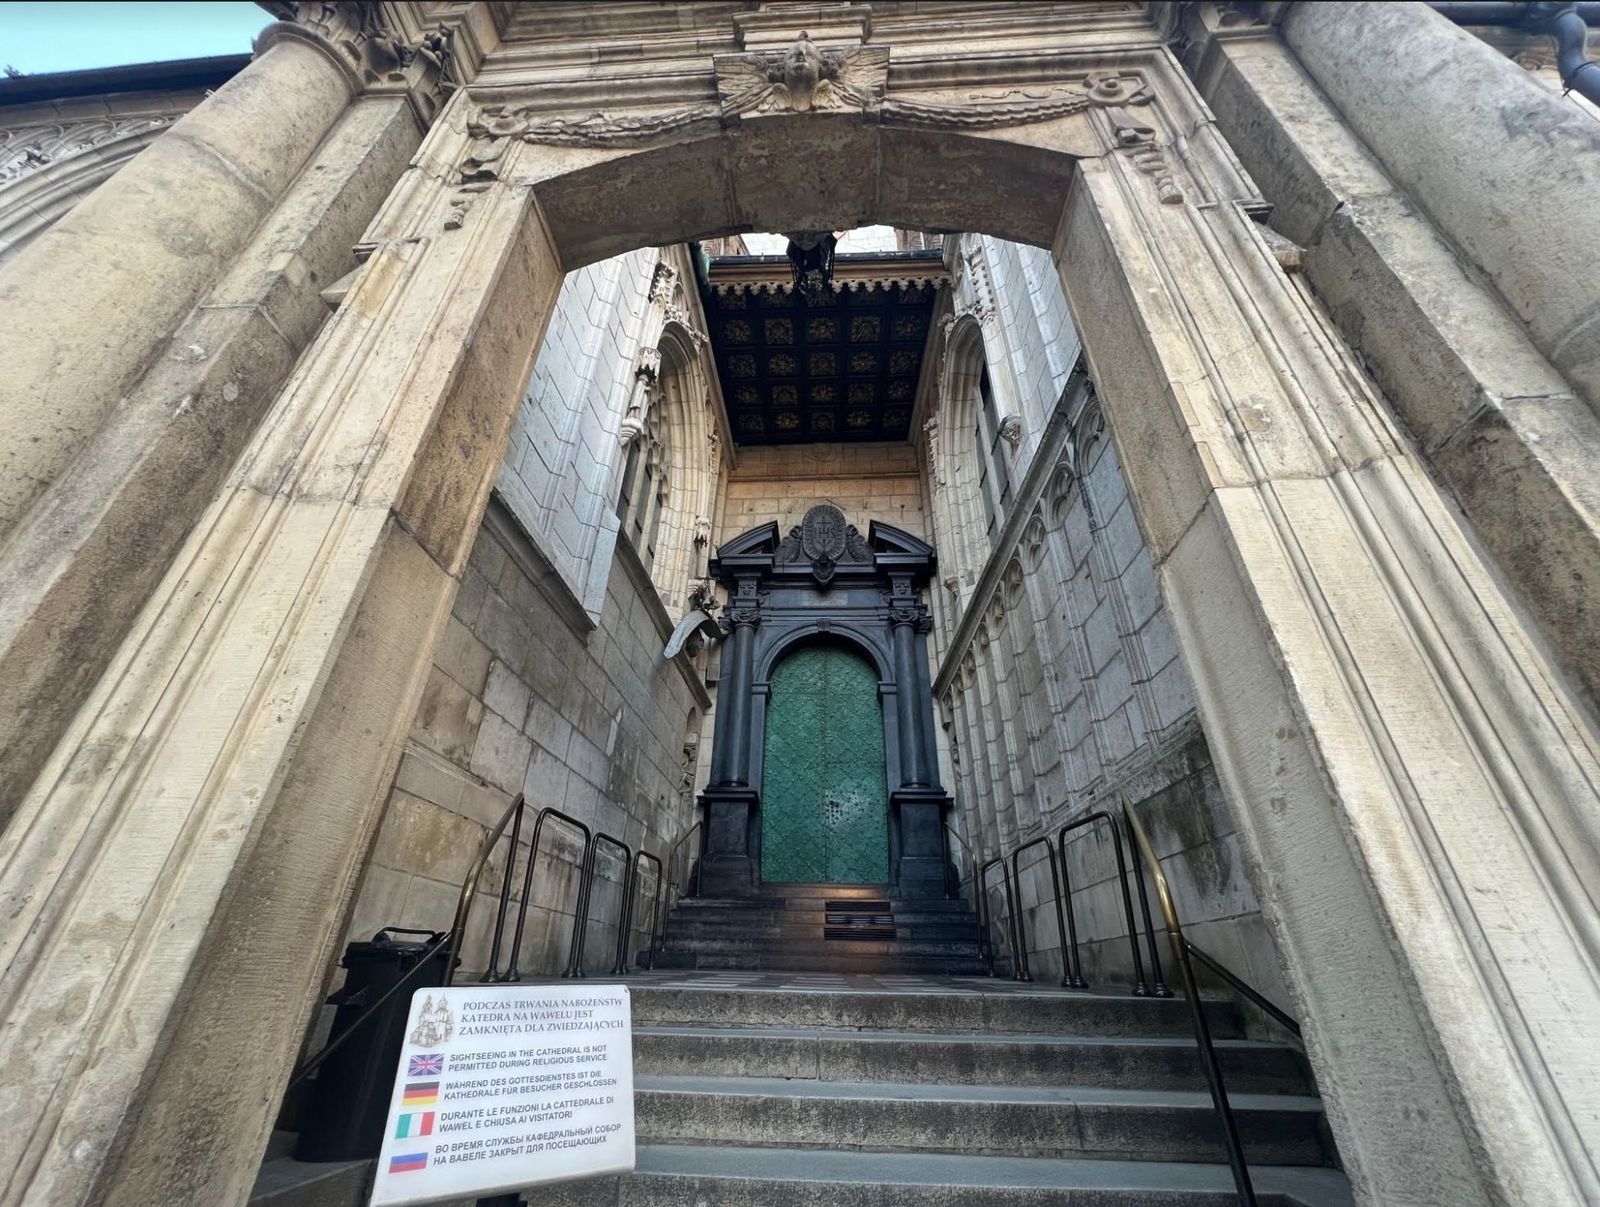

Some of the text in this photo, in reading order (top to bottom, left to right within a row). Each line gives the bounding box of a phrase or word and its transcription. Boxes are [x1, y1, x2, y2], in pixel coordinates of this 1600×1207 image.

[464, 1001, 511, 1010] PODCZAS
[513, 1000, 559, 1009] TRWANIA
[462, 1010, 593, 1022] KATEDRA NA WAWELU JEST
[459, 1020, 624, 1035] ZAMKNIĘTA DLA ZWIEDZAJĄCYCH
[448, 1054, 608, 1072] PERMITTED DURING RELIGIOUS SERVICE
[450, 1051, 506, 1062] SIGHTSEEING
[536, 1046, 582, 1056] CATHEDRAL
[490, 1078, 506, 1086] DES
[508, 1073, 576, 1084] GOTTESDIENSTES
[444, 1088, 500, 1100] KATHEDRALE
[520, 1083, 562, 1093] BESUCHER
[564, 1078, 617, 1089] GESCHLOSSEN
[441, 1109, 484, 1121] DURANTE
[487, 1107, 498, 1116] LE
[500, 1104, 539, 1114] FUNZIONI
[554, 1097, 604, 1109] CATTEDRALE
[439, 1122, 473, 1133] WAWEL
[476, 1120, 481, 1128] E
[484, 1116, 517, 1128] CHIUSA
[529, 1111, 573, 1122] VISITATORI
[435, 1123, 622, 1154] ВО ВРЕМЯ СЛУЖБЫ КАФЕДРАЛЬНЫЙ СОБОР
[433, 1136, 607, 1165] НА ВАВЕЛЕ ЗАКРЫТ ДЛЯ ПОСЕЩАЮЩИХ
